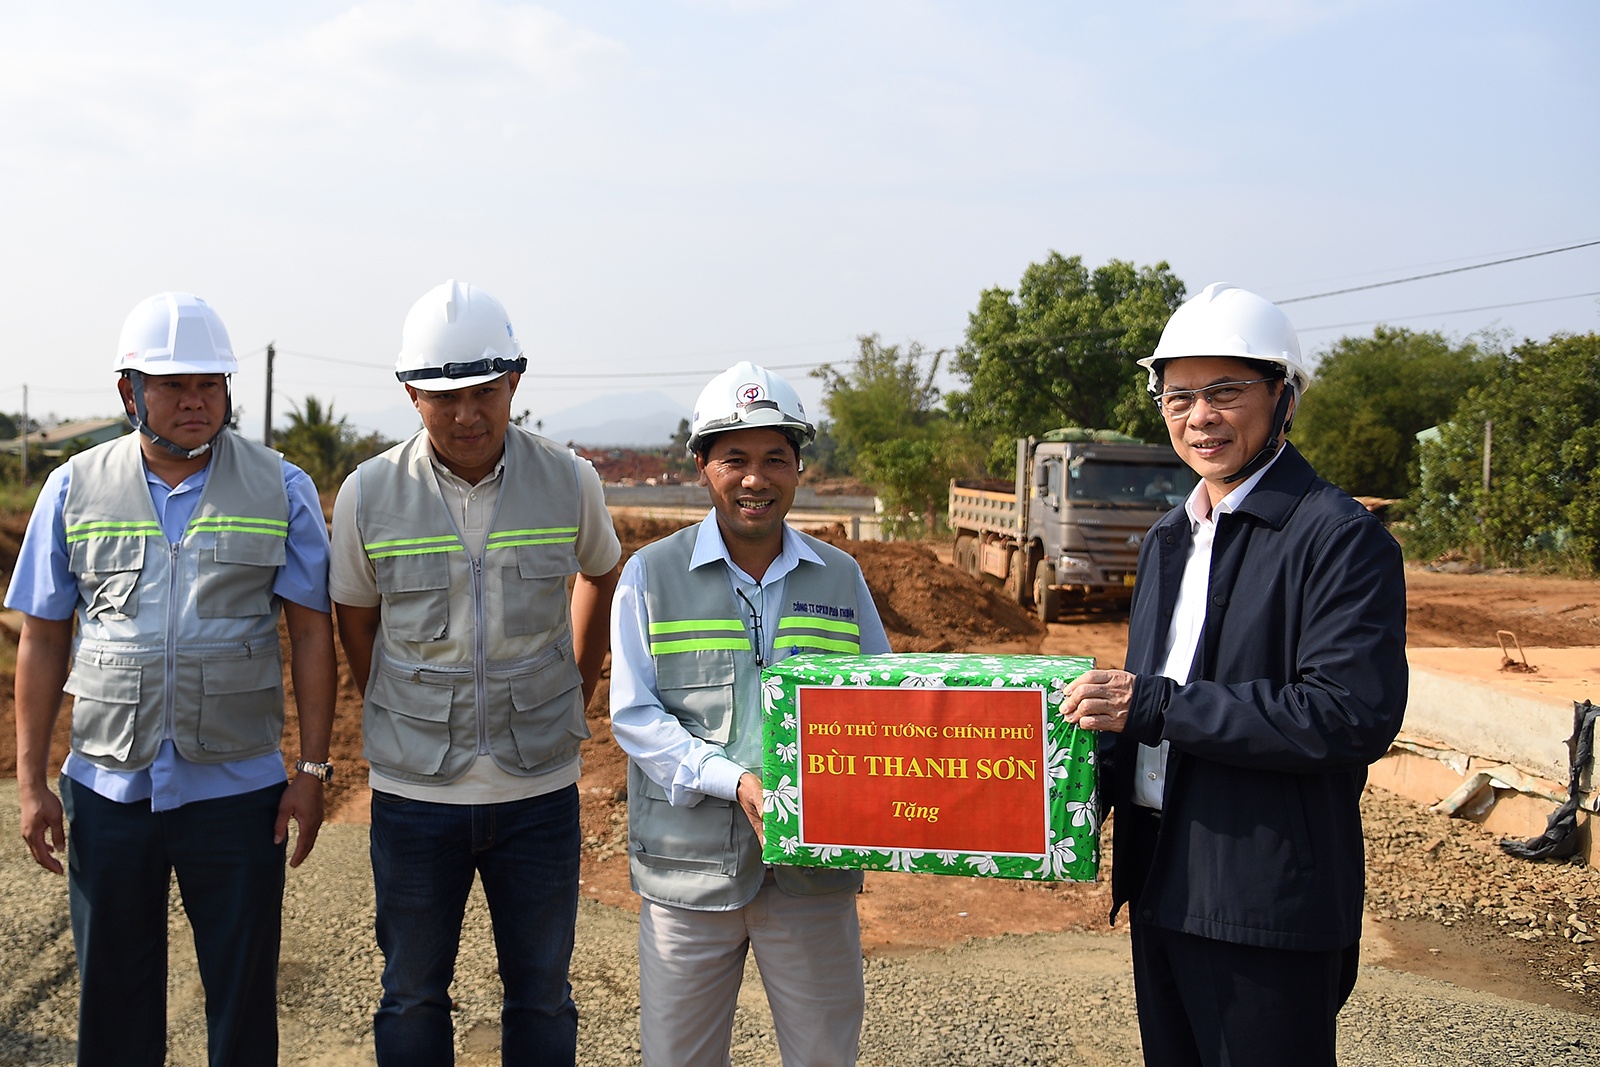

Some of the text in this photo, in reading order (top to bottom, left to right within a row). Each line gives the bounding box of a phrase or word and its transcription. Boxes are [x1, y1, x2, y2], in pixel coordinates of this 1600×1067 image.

[808, 721, 1034, 740] PHÓ THỦ TƯỚNG CHÍNH PHỦ
[808, 748, 1036, 780] BÙI THANH SƠN
[892, 801, 940, 823] Tặng
